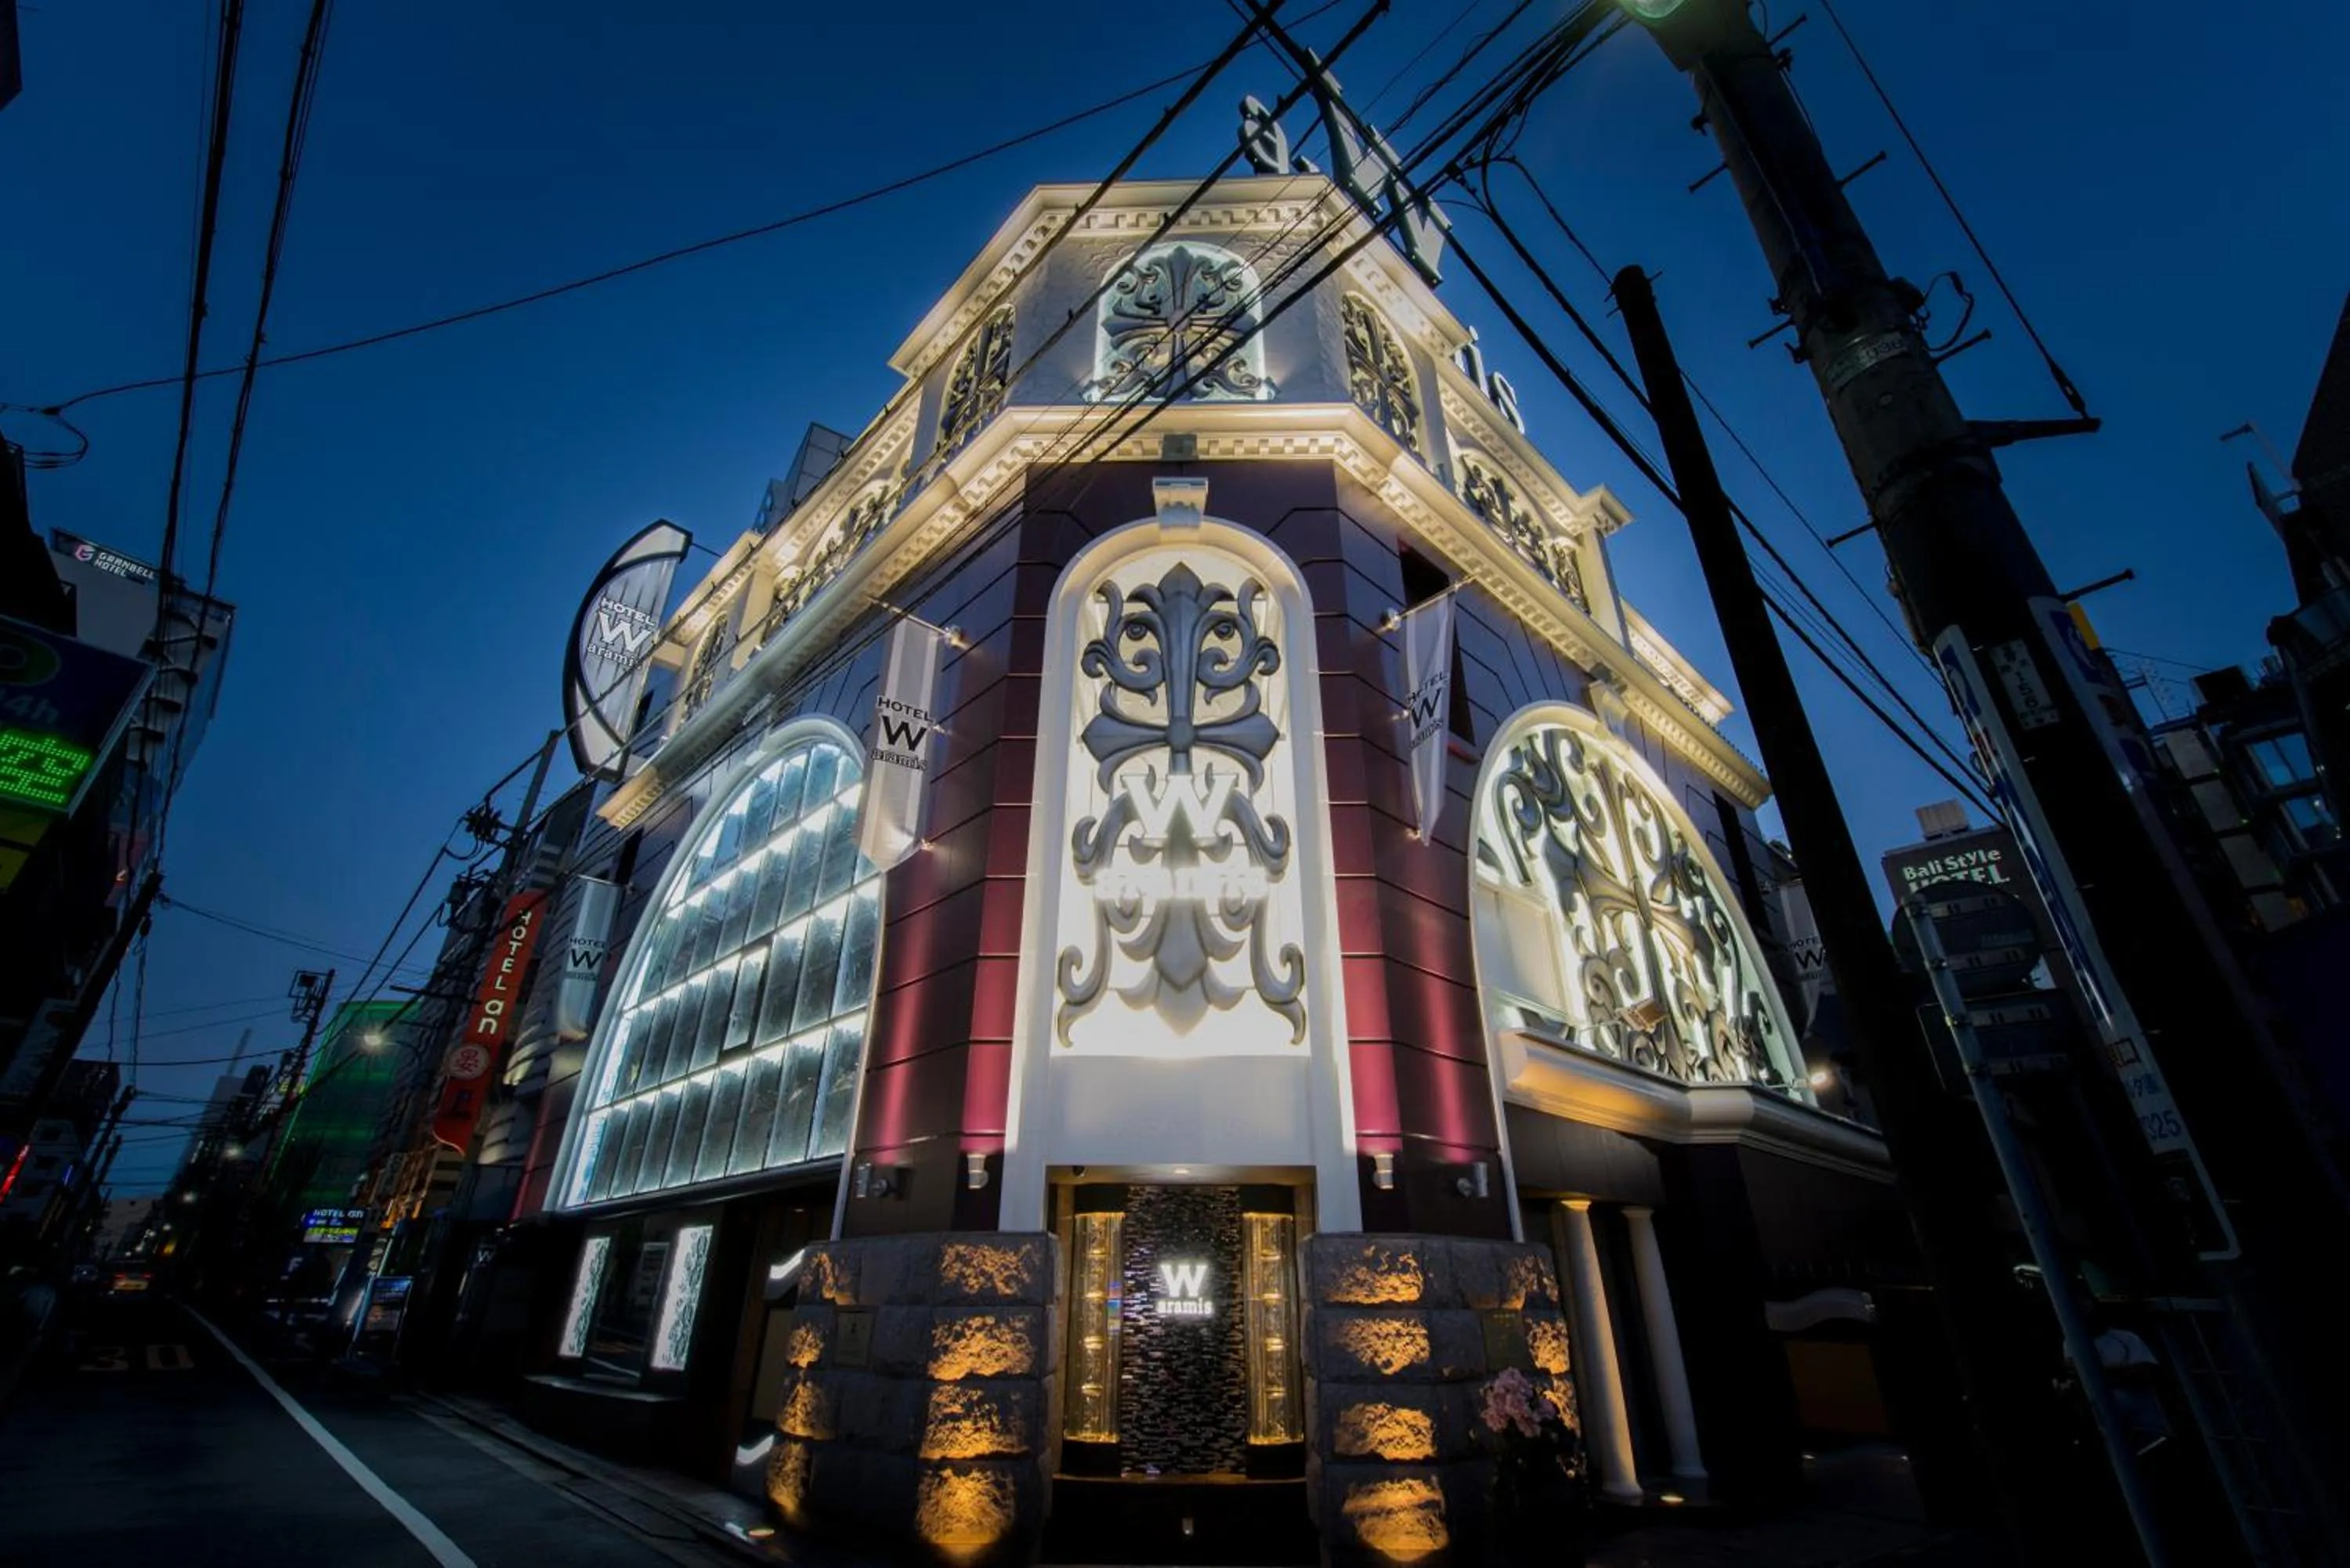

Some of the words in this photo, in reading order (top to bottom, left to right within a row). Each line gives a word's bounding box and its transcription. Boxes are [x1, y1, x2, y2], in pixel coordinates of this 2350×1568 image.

[94, 559, 126, 577] HOTEL
[601, 597, 656, 627] HOTEL
[598, 611, 653, 652] W
[877, 696, 935, 722] HOTEL
[1411, 688, 1442, 729] W
[880, 714, 928, 751] W
[1121, 774, 1239, 840] W
[1902, 858, 1943, 880] Bali
[1944, 849, 2002, 871] Style
[494, 909, 533, 992] HOTEL
[570, 948, 603, 970] W
[1794, 947, 1824, 969] W
[477, 999, 505, 1035] an
[1159, 1264, 1209, 1298] W
[1156, 1297, 1213, 1315] aramis
